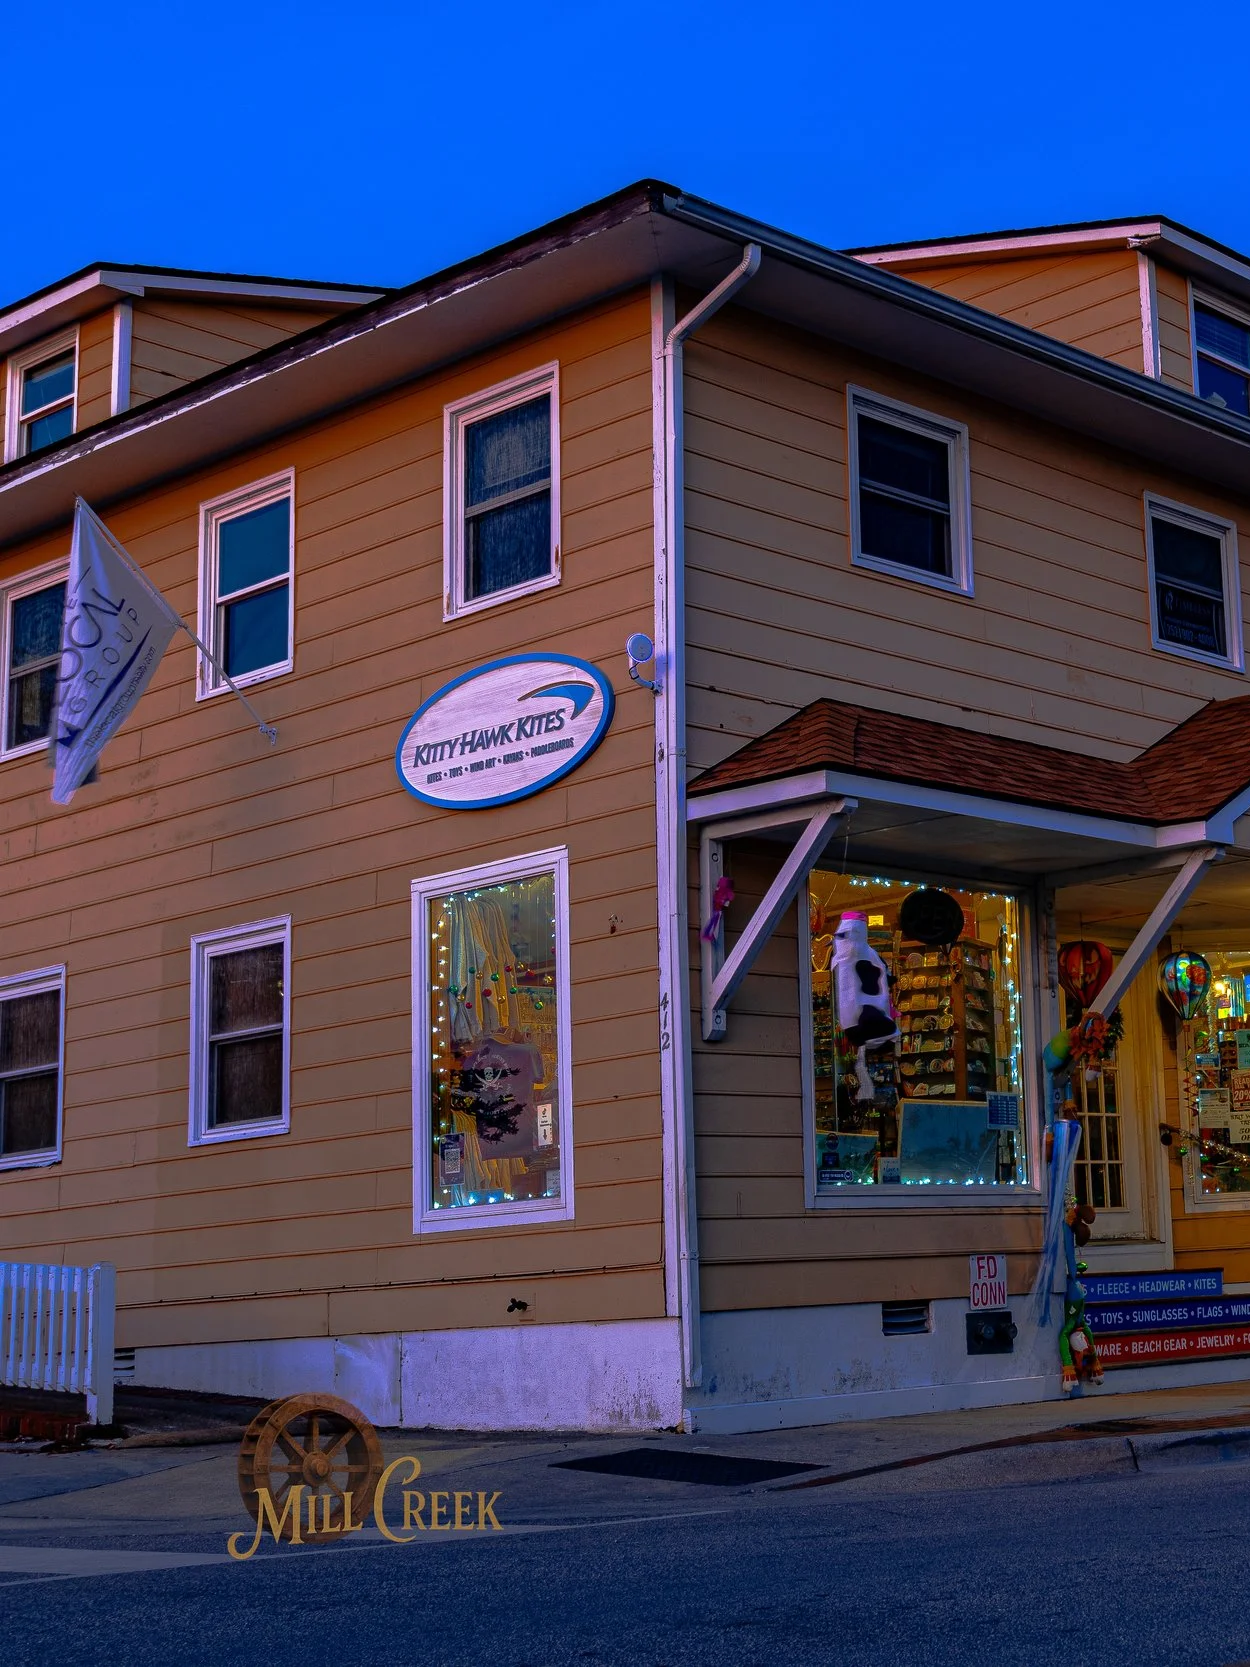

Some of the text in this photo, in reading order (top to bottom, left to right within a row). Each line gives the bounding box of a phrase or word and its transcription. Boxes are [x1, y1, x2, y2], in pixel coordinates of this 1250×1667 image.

[69, 608, 139, 713] GROUP
[413, 708, 566, 768] KITTY HAWK KITES
[449, 766, 463, 779] TOYS
[485, 757, 497, 769] ART
[531, 737, 574, 758] PADDLEBOARDS
[660, 992, 670, 1050] 412
[972, 1281, 1005, 1306] CONN
[1097, 1283, 1129, 1296] FLEECE
[1138, 1280, 1185, 1293] HEADWEAR
[1193, 1278, 1217, 1290] KITES
[1101, 1312, 1123, 1324] TOYS
[1132, 1308, 1188, 1322] SUNGLASSES
[1197, 1306, 1223, 1318] FLAGS
[1132, 1340, 1163, 1354] BEACH
[1164, 1338, 1187, 1352] GEAR
[1196, 1335, 1235, 1349] JEWELRY
